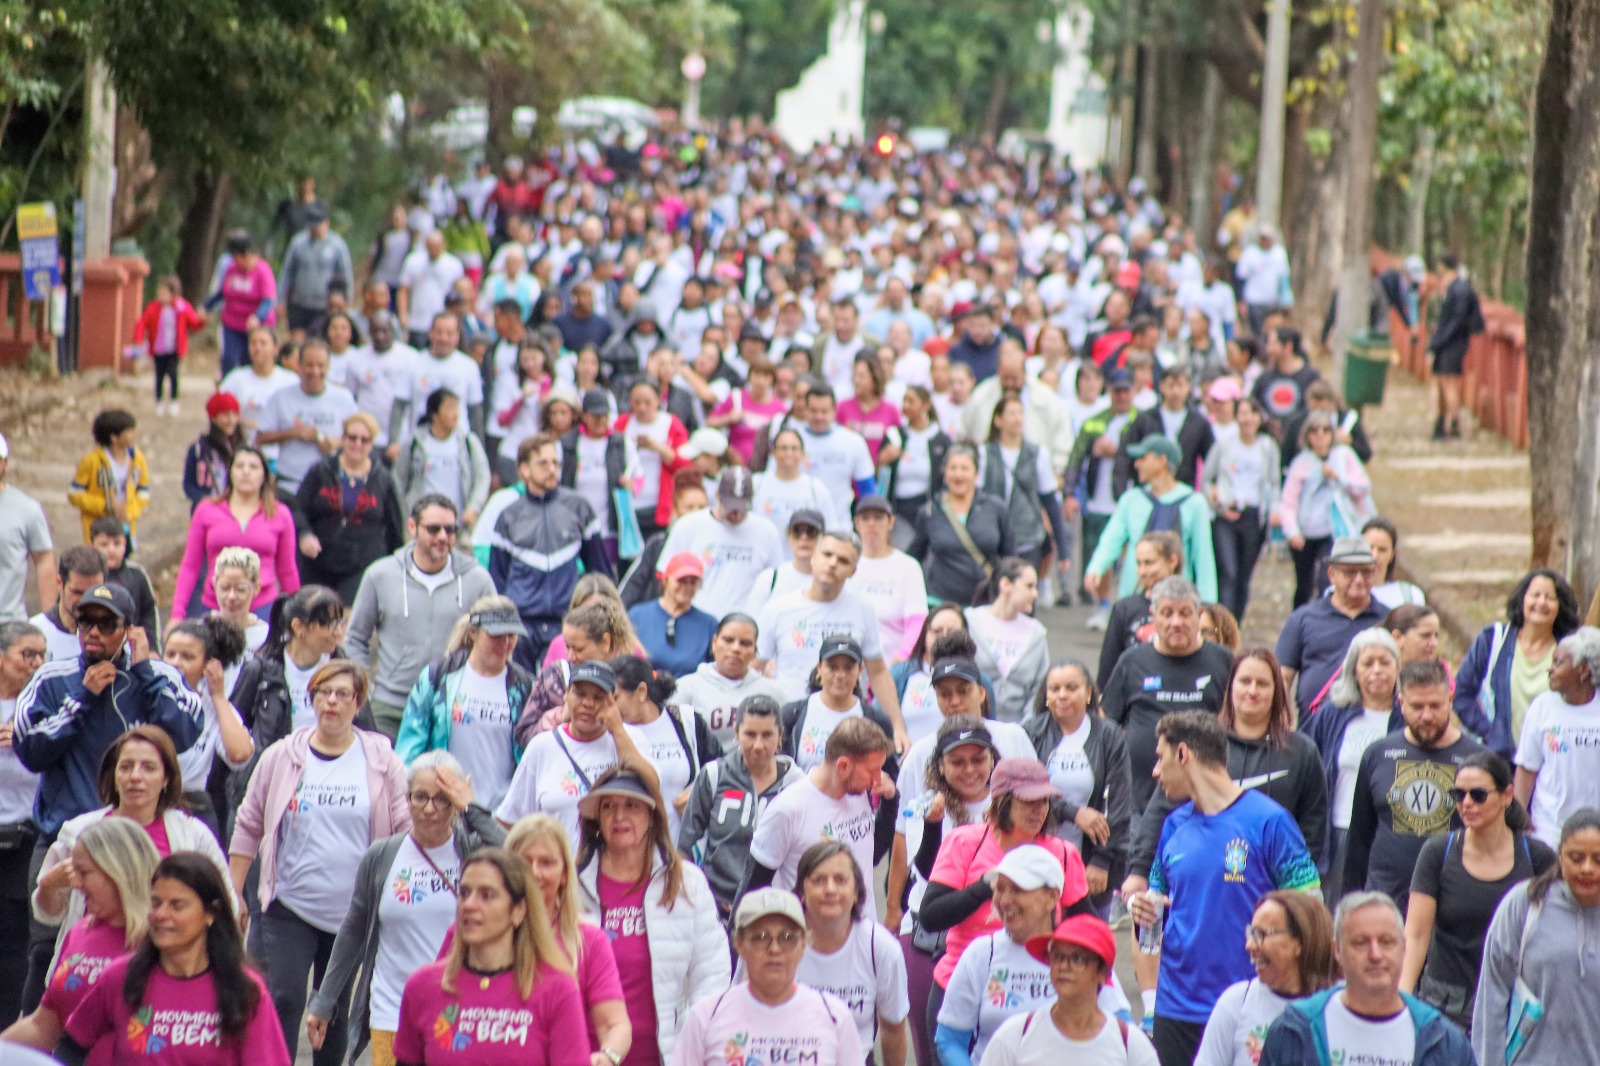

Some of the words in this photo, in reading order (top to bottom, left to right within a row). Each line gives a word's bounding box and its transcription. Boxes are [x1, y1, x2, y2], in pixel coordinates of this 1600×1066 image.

[1156, 690, 1172, 702] NEW
[710, 706, 738, 731] GA
[717, 788, 769, 829] FI
[1411, 782, 1437, 814] XV
[622, 917, 647, 937] BE
[1030, 983, 1058, 999] BE
[460, 1007, 533, 1026] MOVIMENTO
[152, 1023, 169, 1036] DO
[172, 1022, 221, 1047] BEM
[458, 1021, 475, 1034] DO
[477, 1020, 528, 1047] BEM
